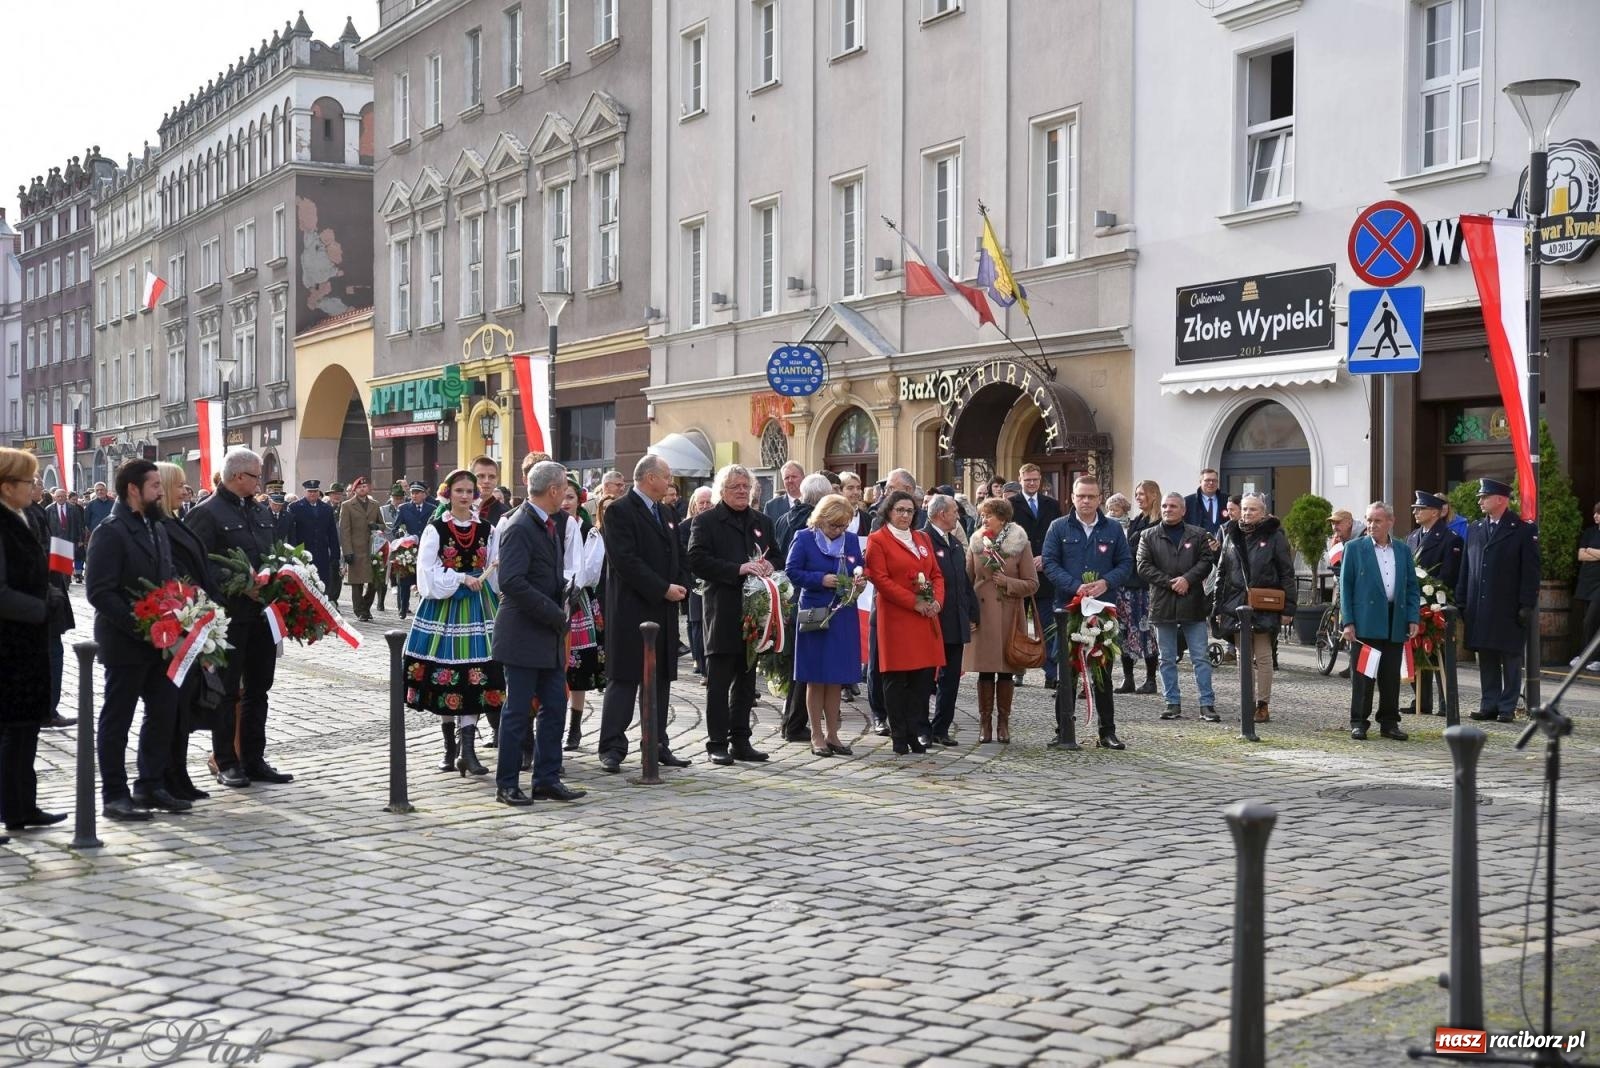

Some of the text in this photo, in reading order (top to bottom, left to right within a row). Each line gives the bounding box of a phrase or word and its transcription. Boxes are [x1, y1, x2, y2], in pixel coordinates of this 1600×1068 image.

[1565, 214, 1600, 240] Rynek
[1549, 242, 1573, 255] AD 2013
[1190, 290, 1225, 308] Cukiernia
[1183, 298, 1324, 343] Złote Wypieki
[778, 366, 813, 375] KANTOR
